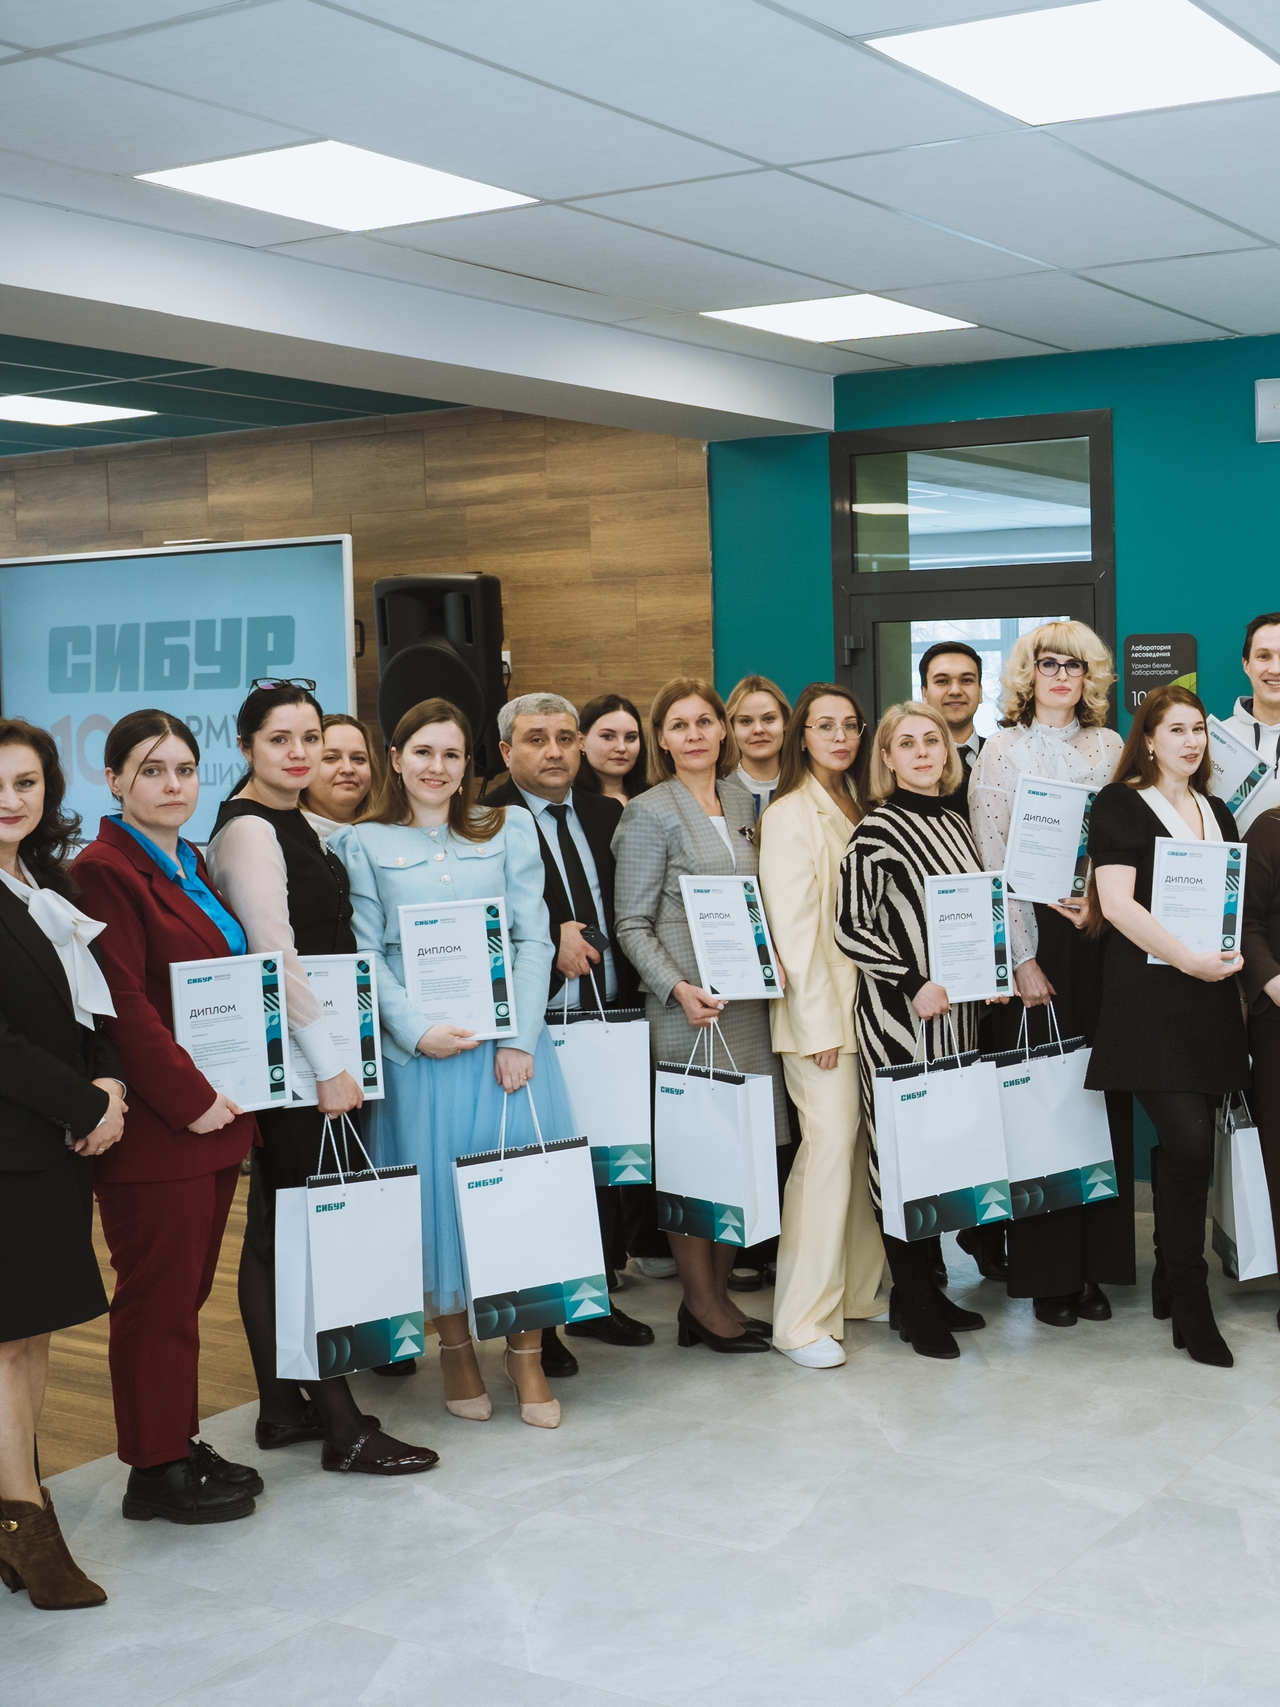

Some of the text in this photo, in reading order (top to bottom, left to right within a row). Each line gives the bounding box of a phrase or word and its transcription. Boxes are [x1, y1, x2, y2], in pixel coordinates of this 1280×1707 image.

[48, 615, 295, 694] СИБУР
[1132, 691, 1150, 706] 10
[1023, 813, 1060, 825] ДИПЛОМ
[1165, 876, 1202, 884] ДИПЛОМ
[939, 913, 973, 922] ДИПЛОМ
[417, 945, 462, 957] ДИПЛОМ
[187, 975, 213, 985] СИБУР
[189, 1004, 236, 1019] ДИПЛОМ
[1003, 1076, 1031, 1088] СИБУР
[660, 1085, 685, 1096] СИБУР
[900, 1089, 928, 1102] СИБУР
[467, 1176, 503, 1189] СИБУР
[315, 1202, 346, 1213] СИБУР
